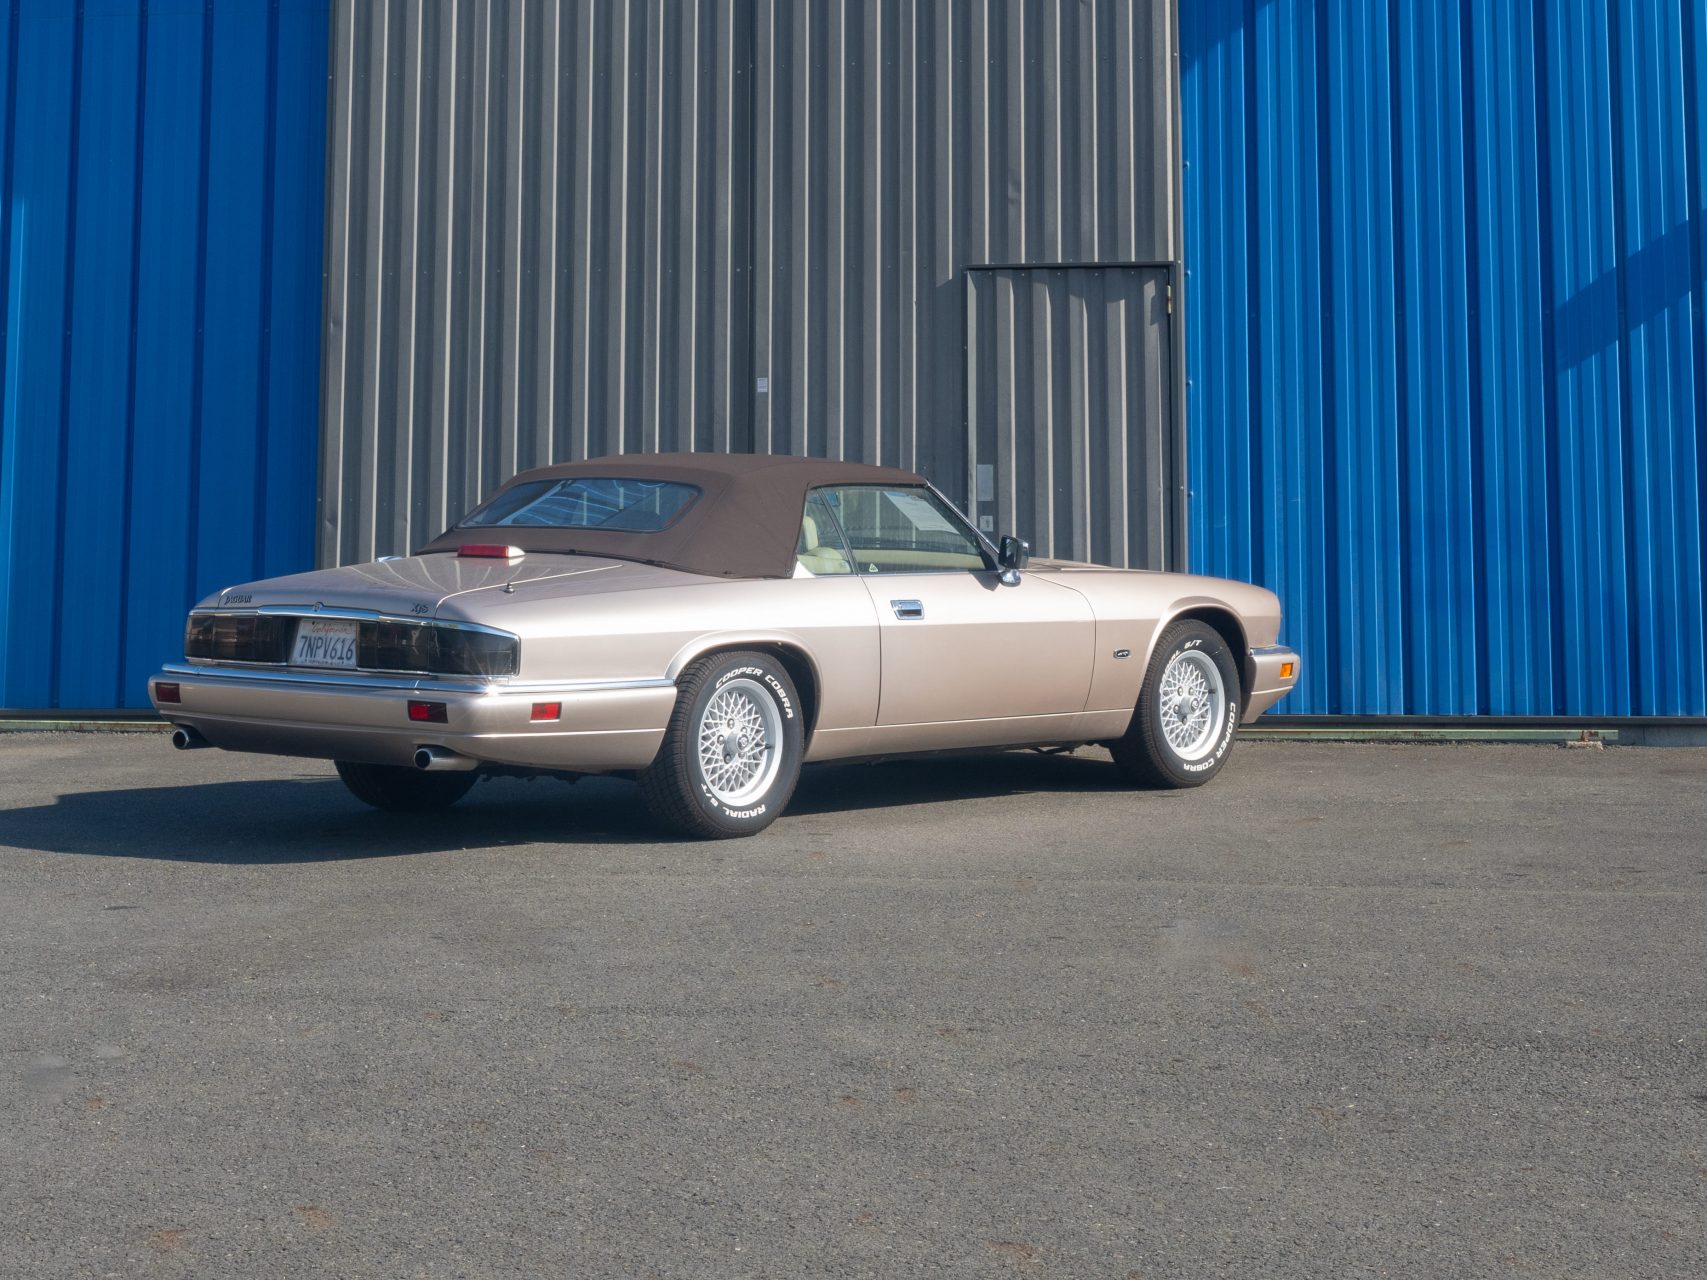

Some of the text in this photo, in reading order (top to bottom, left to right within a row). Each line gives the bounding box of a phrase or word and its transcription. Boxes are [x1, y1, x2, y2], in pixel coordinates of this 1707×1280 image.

[299, 635, 357, 661] 7NPV616
[715, 666, 794, 719] COOPER COBRA
[1183, 702, 1236, 772] COOPER COBRA
[722, 803, 767, 819] RADIAL
